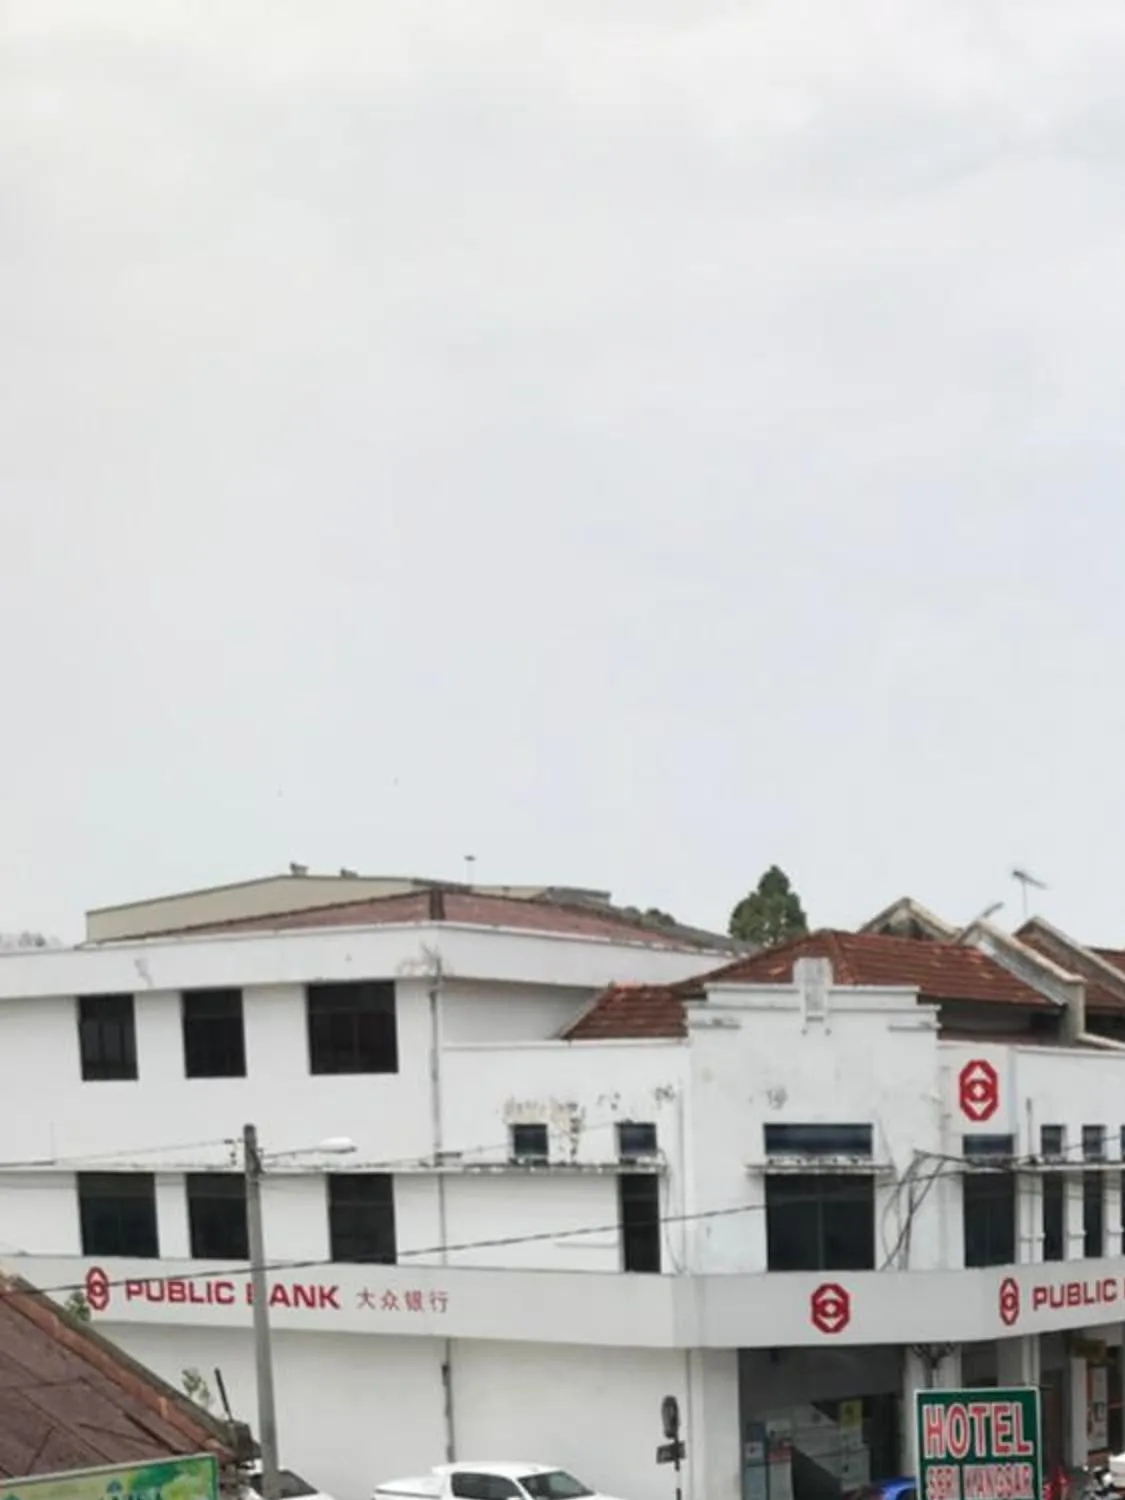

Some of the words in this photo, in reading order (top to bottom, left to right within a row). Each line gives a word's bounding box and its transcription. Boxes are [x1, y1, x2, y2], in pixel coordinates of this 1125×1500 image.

[125, 1278, 235, 1306] PUBLIC
[248, 1283, 341, 1310] ANK
[1032, 1279, 1118, 1311] PUBLIC
[922, 1401, 1034, 1460] HOTEL
